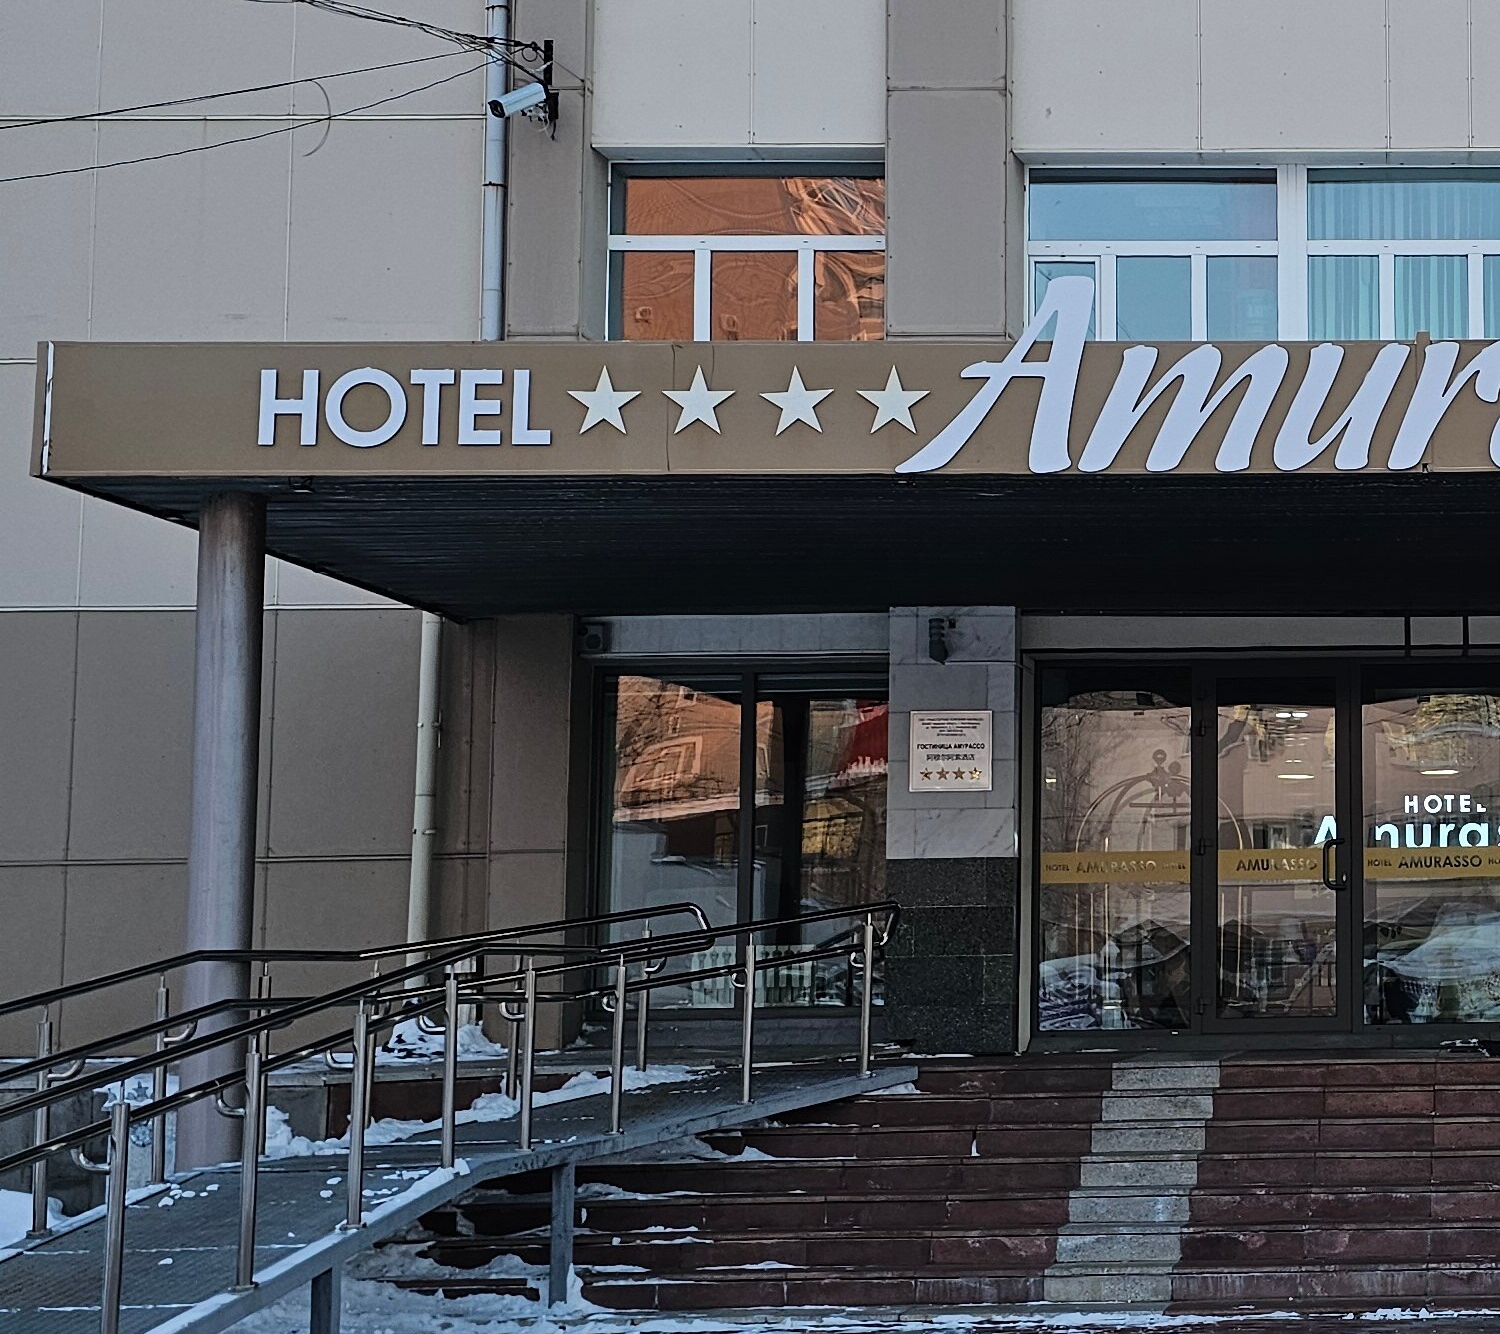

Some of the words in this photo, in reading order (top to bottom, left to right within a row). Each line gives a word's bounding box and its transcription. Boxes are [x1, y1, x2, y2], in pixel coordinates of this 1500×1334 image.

[257, 366, 552, 449] HOTEL
[1367, 858, 1392, 867] HOTEL
[1398, 855, 1482, 869] AMURASSO
